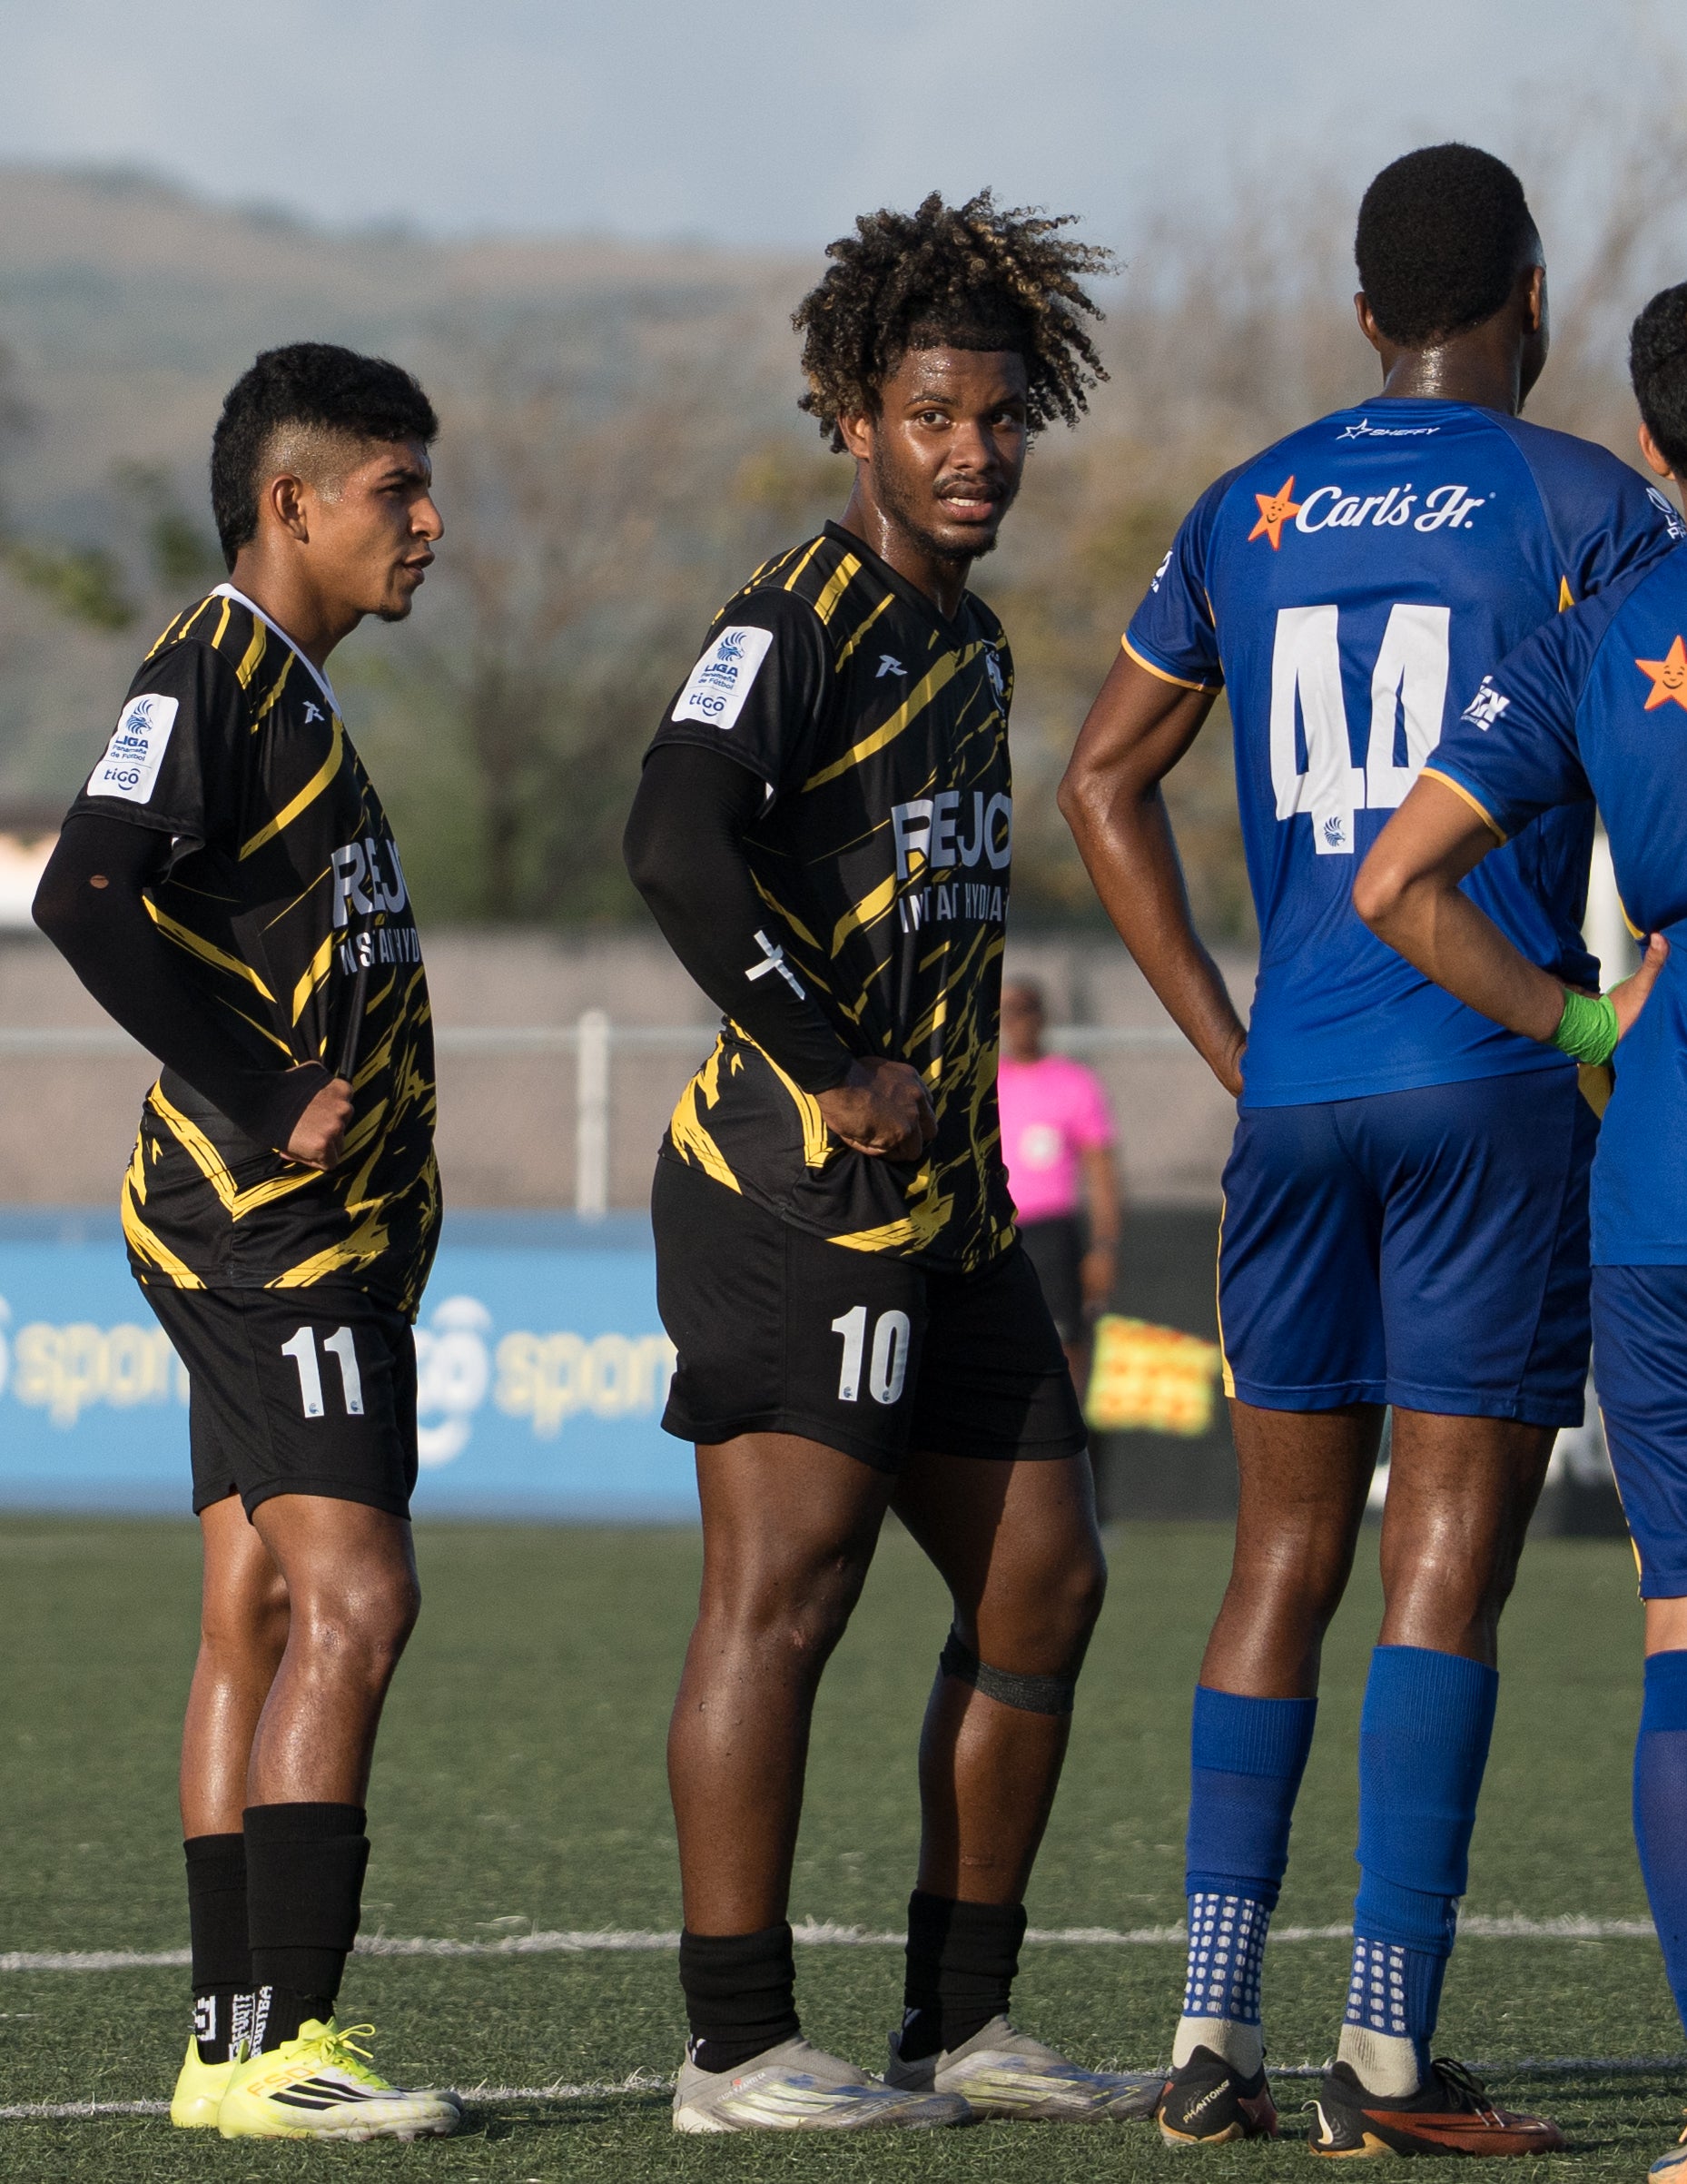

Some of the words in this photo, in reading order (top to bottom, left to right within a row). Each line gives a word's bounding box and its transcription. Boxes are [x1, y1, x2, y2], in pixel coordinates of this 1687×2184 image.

[1369, 427, 1441, 437] SHEFFY
[1296, 483, 1418, 533] Carl's
[1414, 485, 1485, 532] Jr.
[705, 663, 739, 677] LIGA
[115, 736, 149, 749] LIGA
[1270, 604, 1450, 855] 44
[281, 1326, 365, 1418] 11
[831, 1306, 911, 1405] 10
